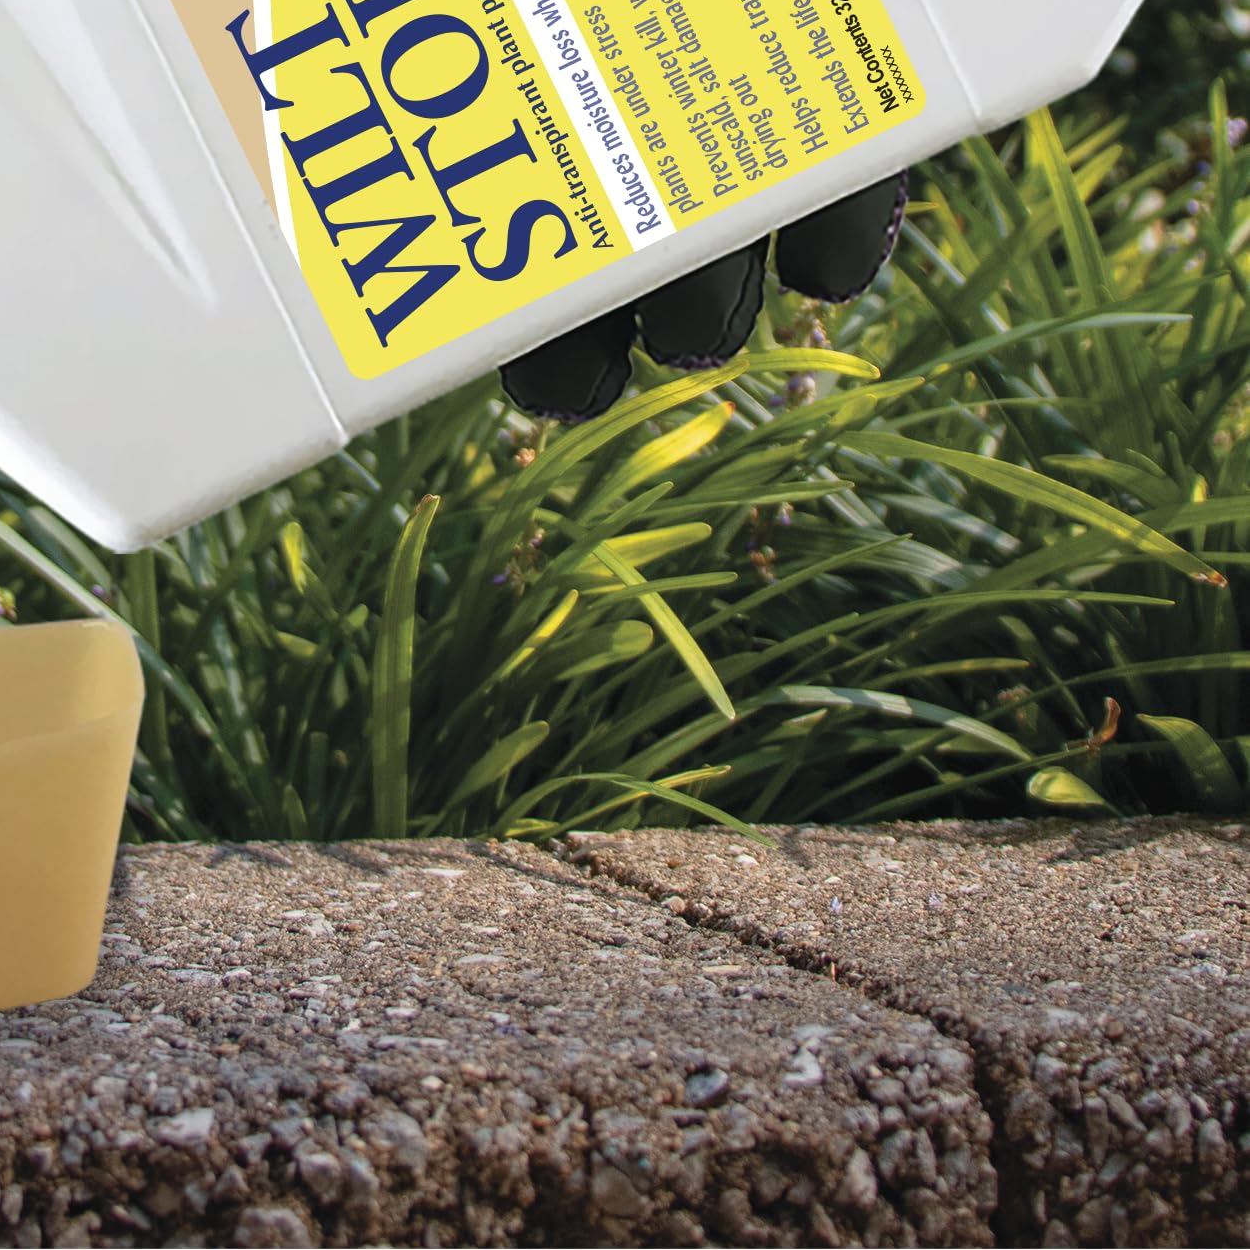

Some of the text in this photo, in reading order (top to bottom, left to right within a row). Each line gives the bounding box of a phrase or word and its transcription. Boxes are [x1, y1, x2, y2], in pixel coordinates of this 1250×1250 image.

[487, 17, 535, 76] plant
[552, 29, 582, 71] loss
[634, 10, 668, 51] kill,
[759, 30, 802, 95] reduce
[808, 26, 836, 60] the
[844, 14, 885, 84] Contents
[584, 5, 704, 214] plants are under stress
[656, 49, 697, 111] winter
[688, 56, 721, 93] salt
[821, 60, 870, 135] Extends
[874, 81, 900, 113] Net
[571, 69, 623, 152] moisture
[705, 95, 764, 181] sunscald,
[728, 73, 789, 169] drying out
[791, 97, 829, 155] Helps
[224, 2, 461, 348] WILT
[517, 78, 614, 249] Anti-transpirant
[687, 112, 739, 198] Prevents
[612, 153, 662, 235] Reduces
